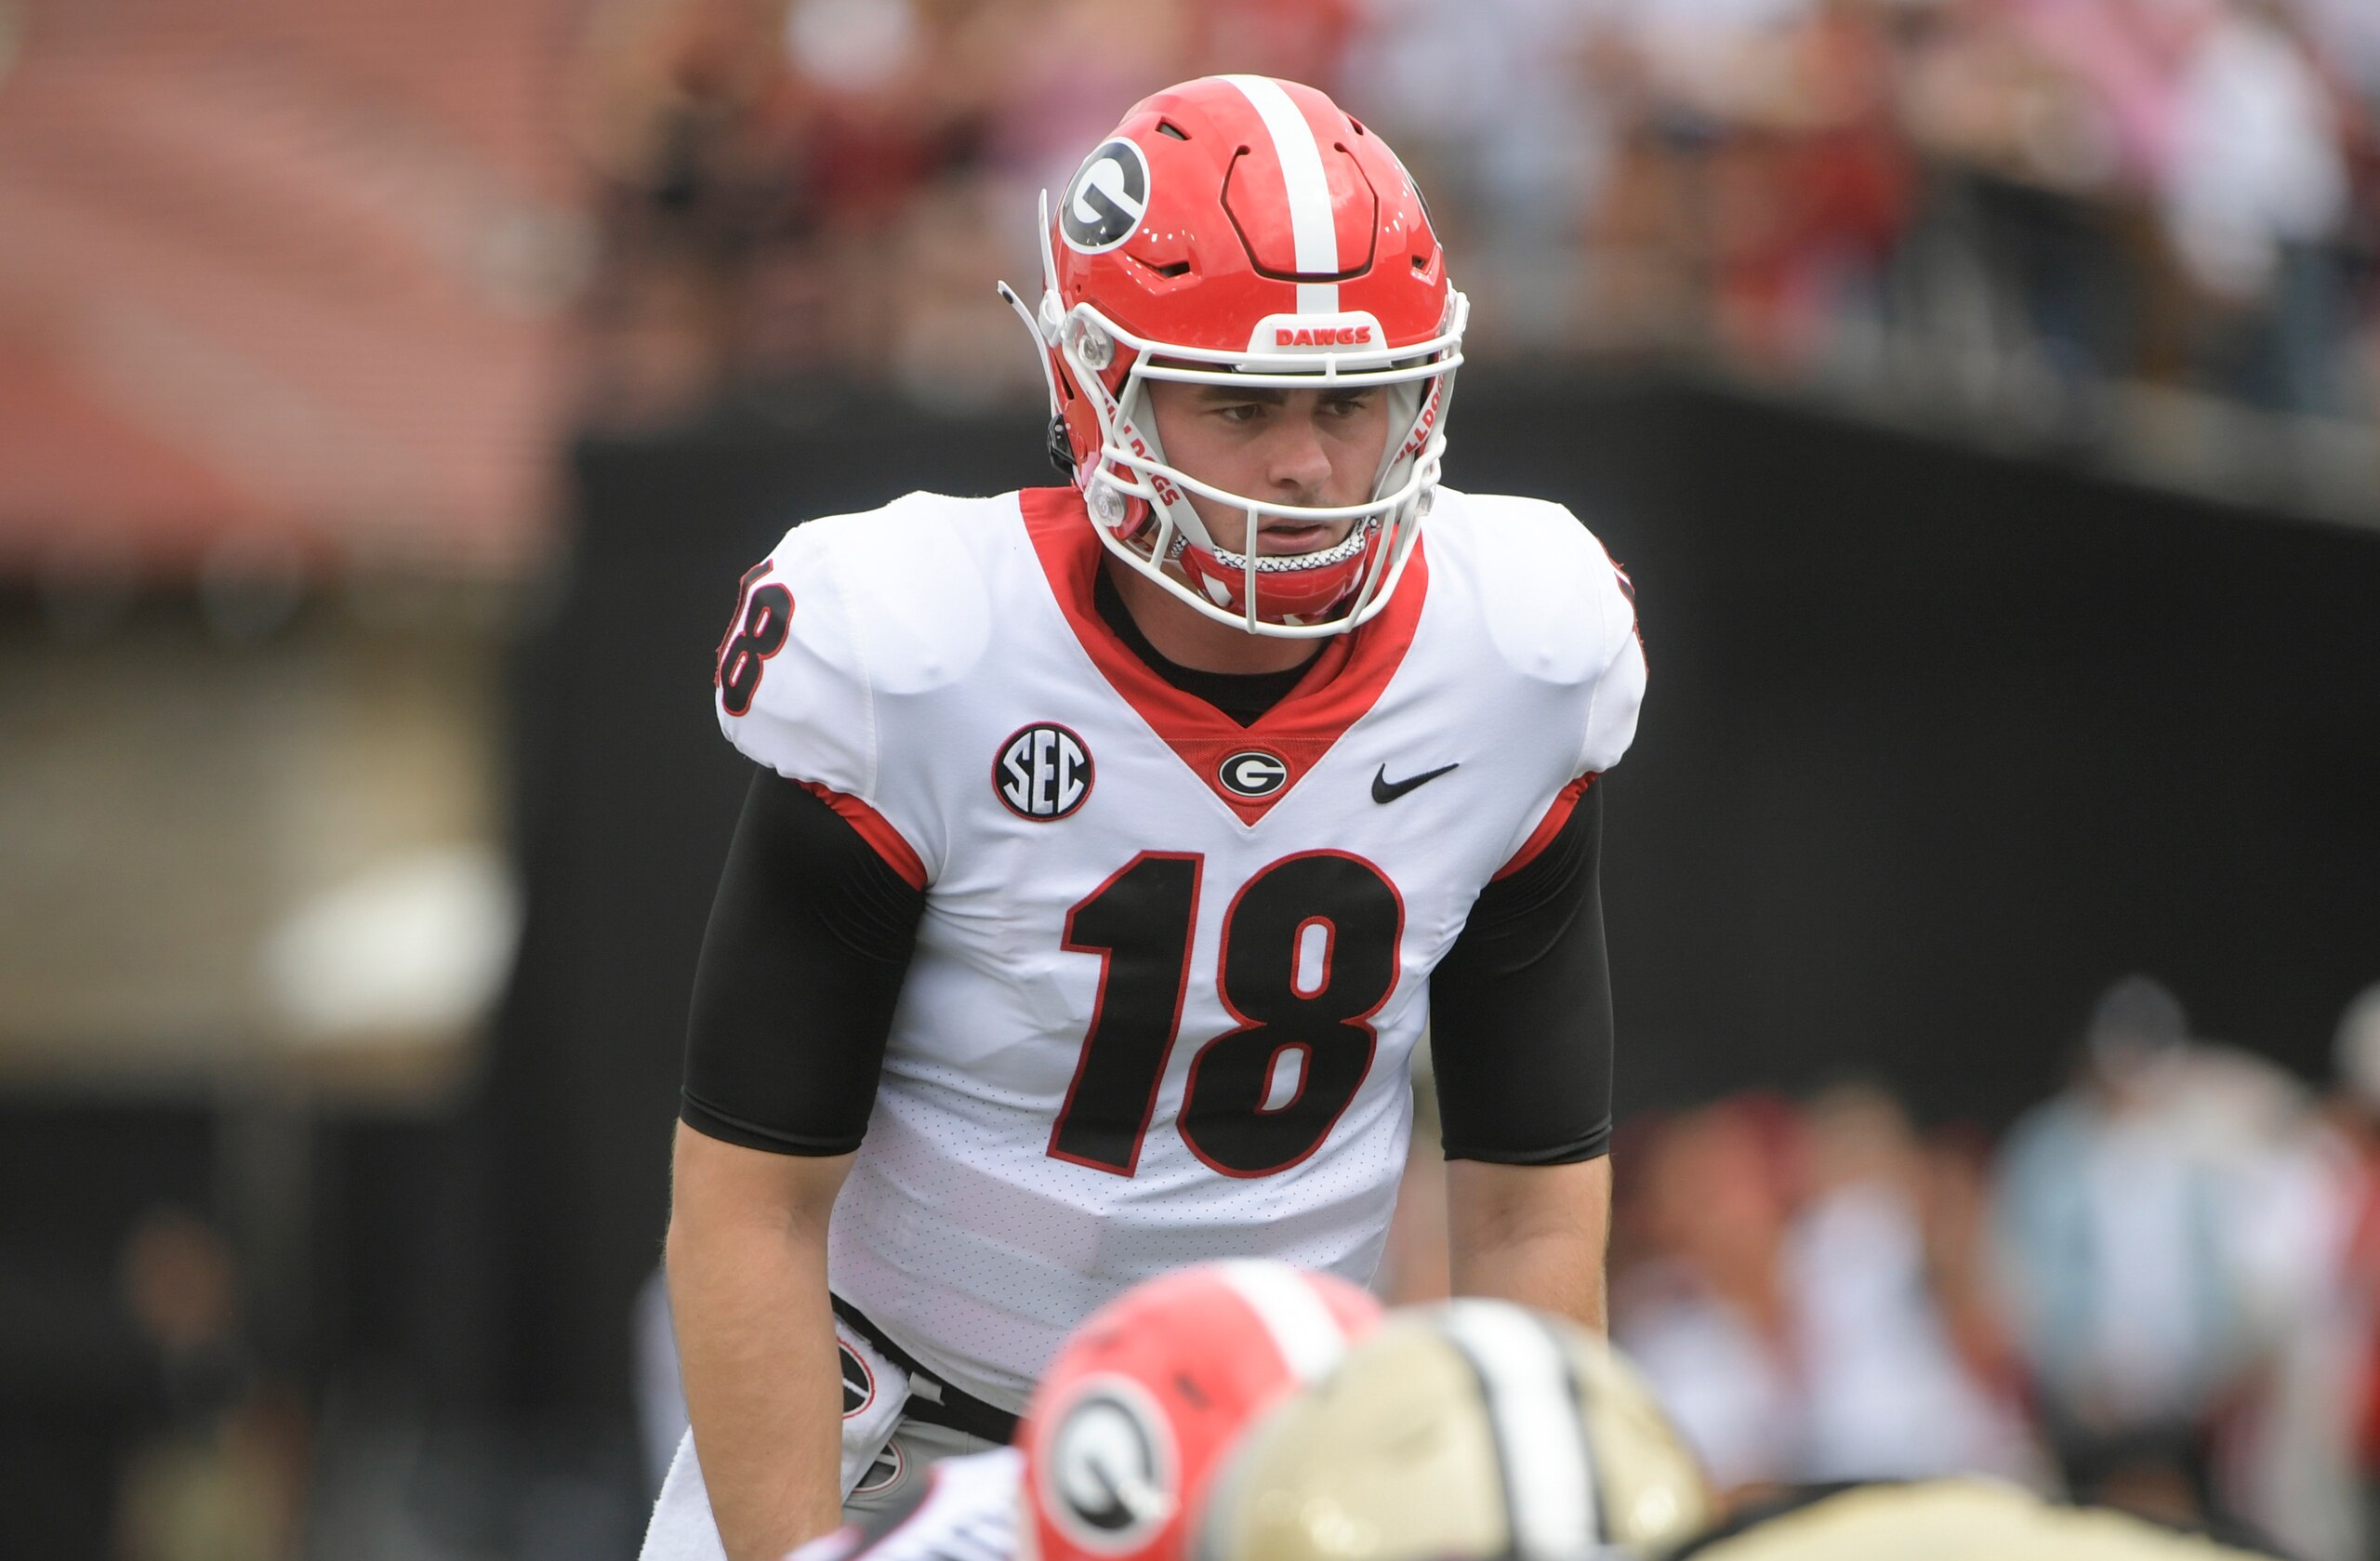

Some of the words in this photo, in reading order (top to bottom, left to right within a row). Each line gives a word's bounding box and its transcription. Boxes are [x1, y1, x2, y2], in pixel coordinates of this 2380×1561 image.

[1060, 138, 1149, 253] G
[1275, 325, 1372, 346] DAWGS
[1002, 729, 1085, 814] SEC
[1220, 752, 1287, 796] G
[1046, 848, 1405, 1179] 18
